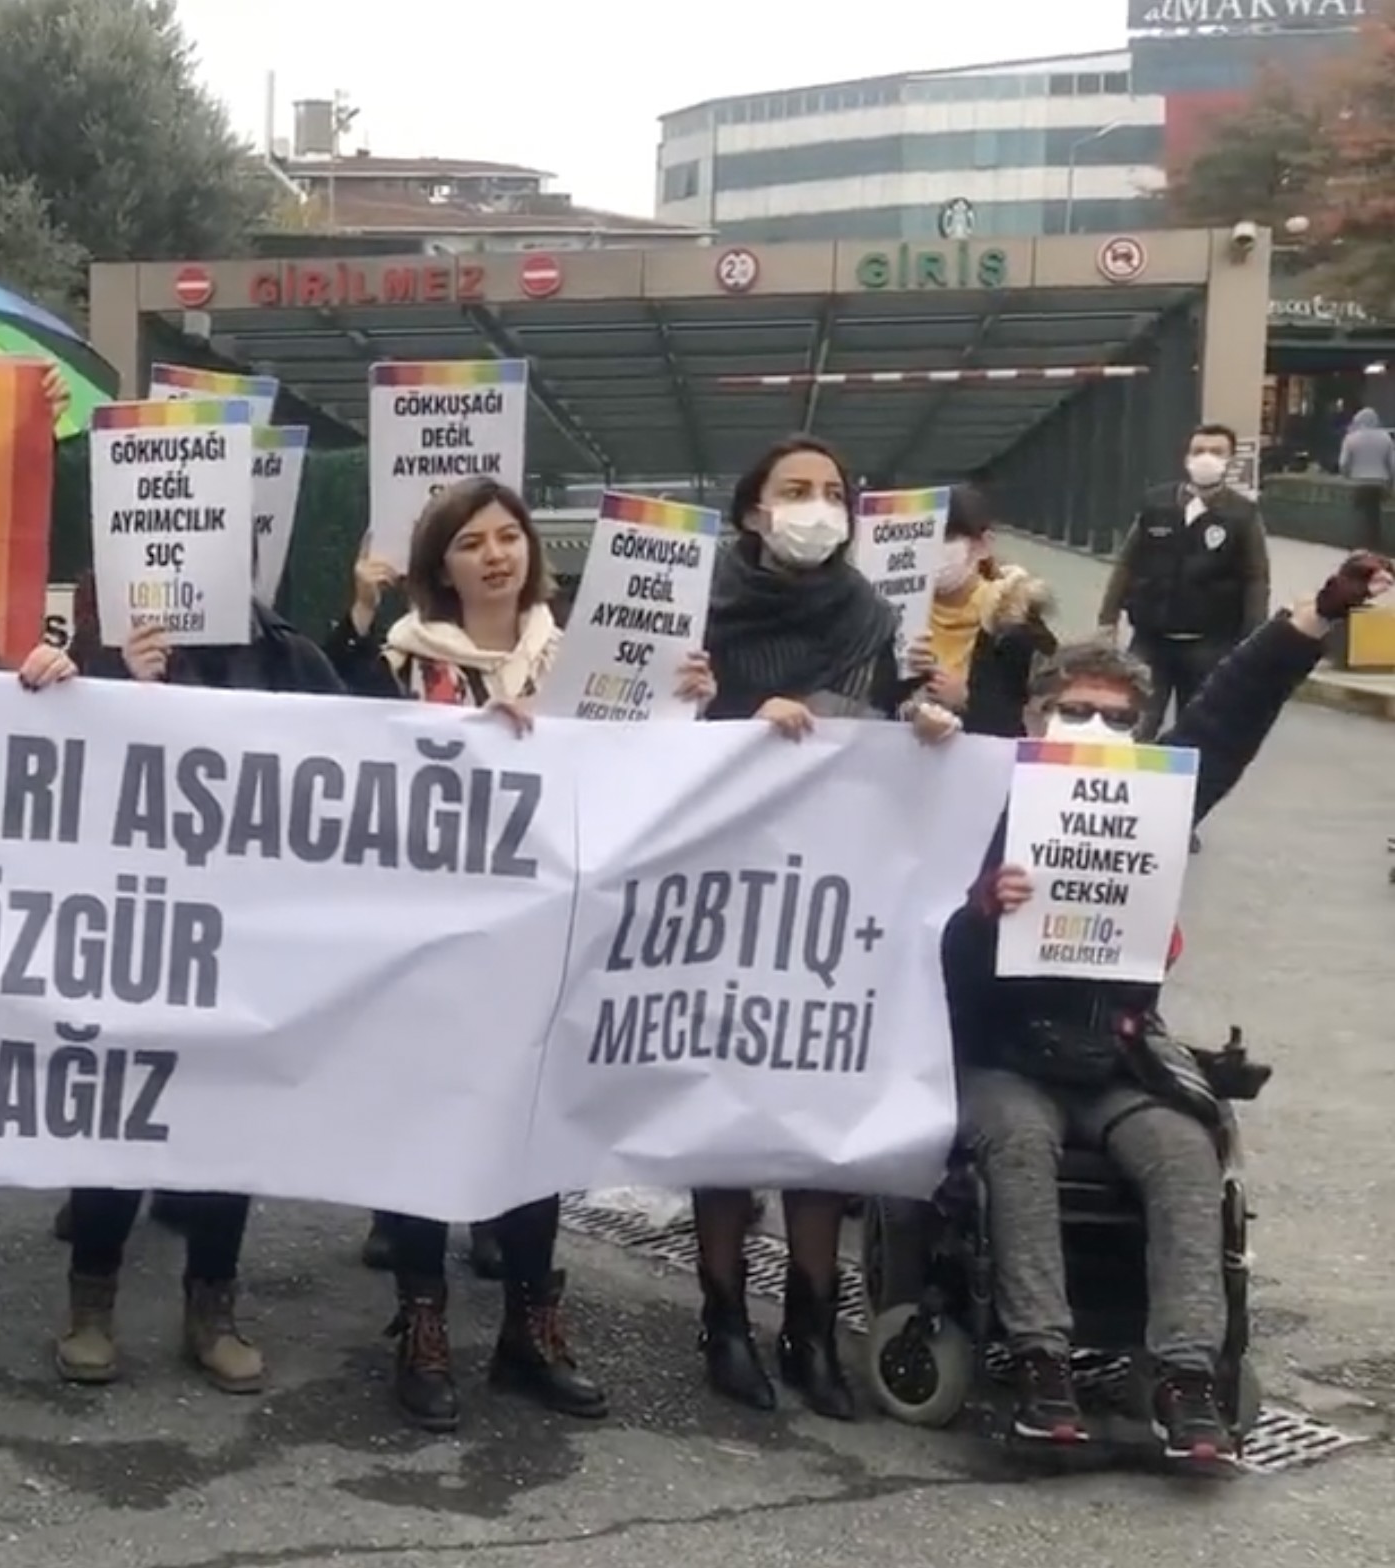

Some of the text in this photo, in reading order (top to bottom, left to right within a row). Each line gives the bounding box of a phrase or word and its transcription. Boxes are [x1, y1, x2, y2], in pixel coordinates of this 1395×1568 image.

[394, 389, 503, 421] GÖKKUŞAĞI
[110, 430, 226, 467] GÖKKUŞAĞI
[421, 421, 474, 449] DEĞİL
[393, 453, 501, 476] AYRIMCILIK
[137, 469, 194, 501] DEĞİL
[110, 507, 226, 535] AYRIMCILIK
[144, 542, 185, 573] SUÇ
[611, 528, 701, 573] GÖKKUŞAĞI
[627, 570, 675, 603] DEĞİL
[590, 602, 693, 638] AYRIMCILIK
[614, 640, 654, 673] SUÇ
[1071, 778, 1130, 804] ASLA
[112, 738, 542, 878] AŞACAĞIZ
[1060, 811, 1139, 840] YALNIZ
[1031, 839, 1159, 875] YÜRÜMEYE-
[1050, 878, 1130, 905] CEKSİN
[606, 853, 885, 990] LGBTİQ+
[587, 979, 876, 1073] MECLİSLERİ
